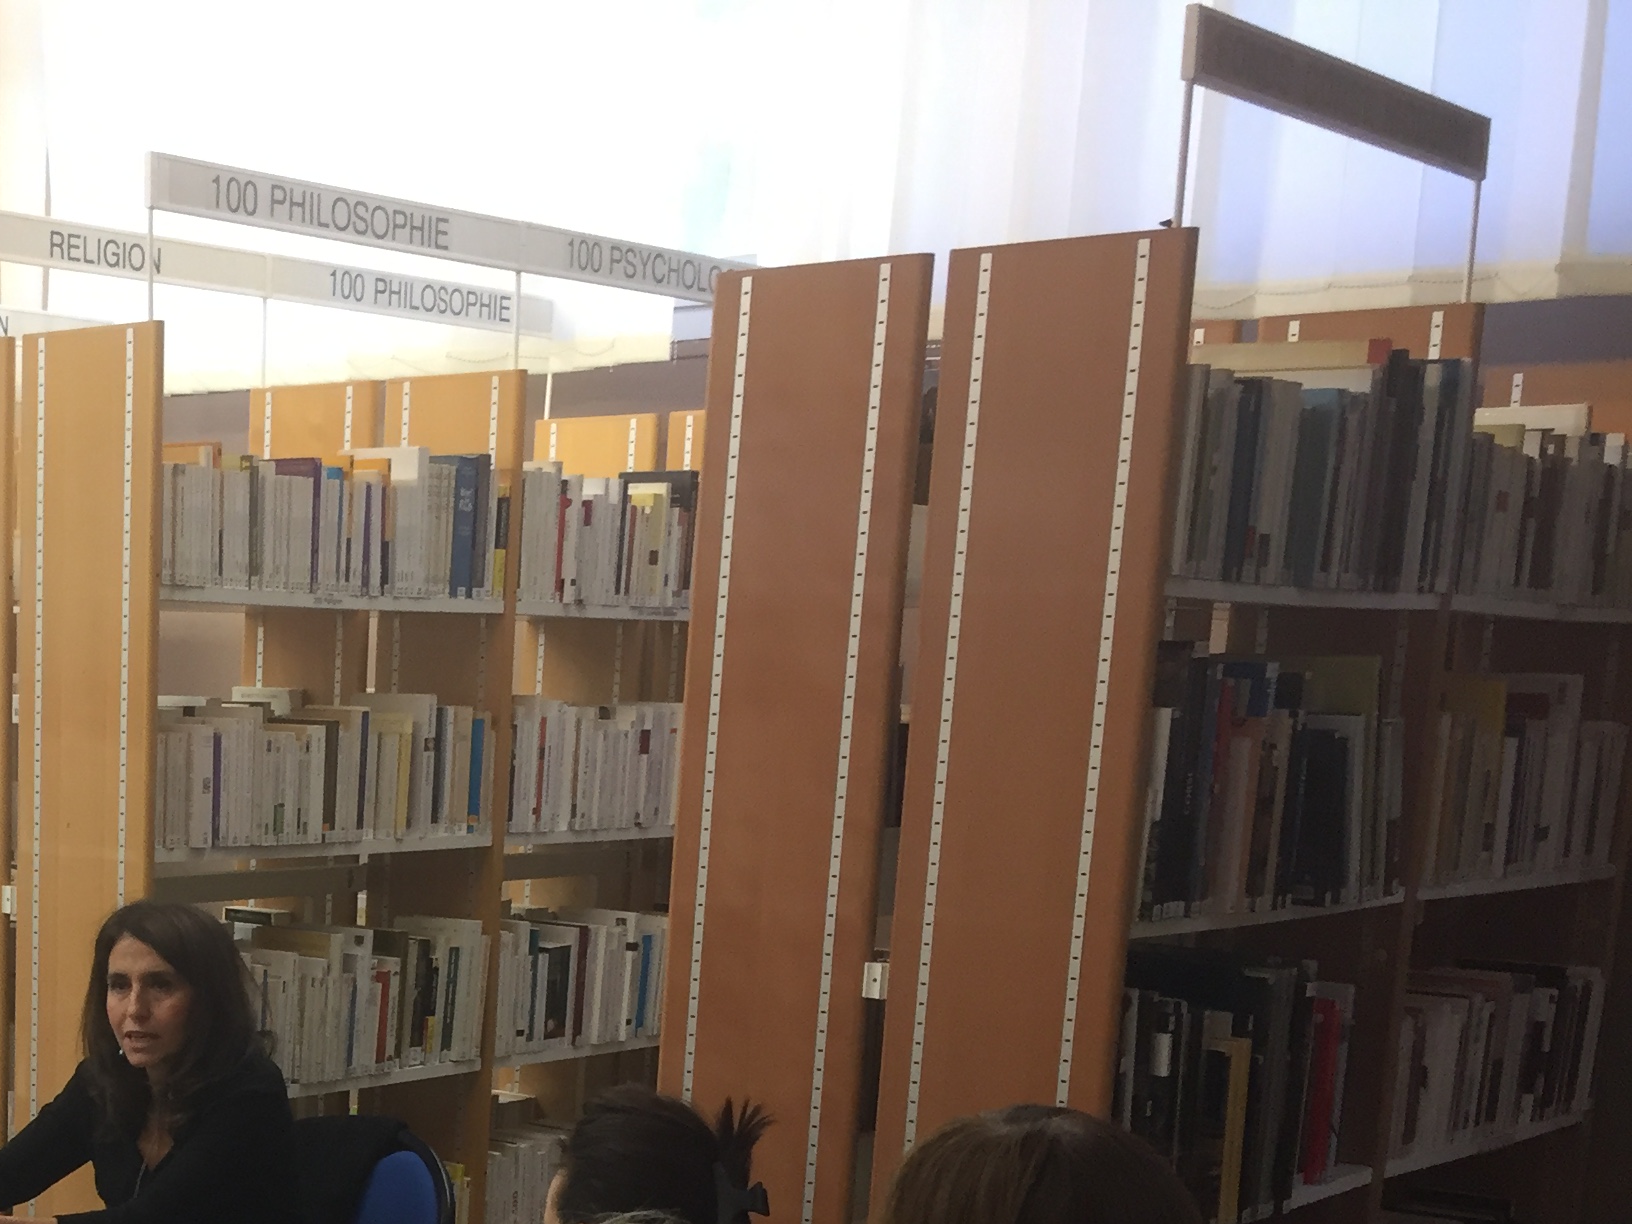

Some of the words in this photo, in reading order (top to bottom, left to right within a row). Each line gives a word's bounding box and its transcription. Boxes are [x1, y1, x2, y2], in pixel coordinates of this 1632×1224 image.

[210, 174, 258, 217] 100
[269, 184, 450, 251] PHILOSOPHIE
[49, 229, 162, 275] RELIGION
[568, 237, 603, 273] 100
[609, 245, 730, 293] PSYCHOLO
[328, 268, 364, 303] 100
[374, 278, 512, 323] PHILOSOPHIE
